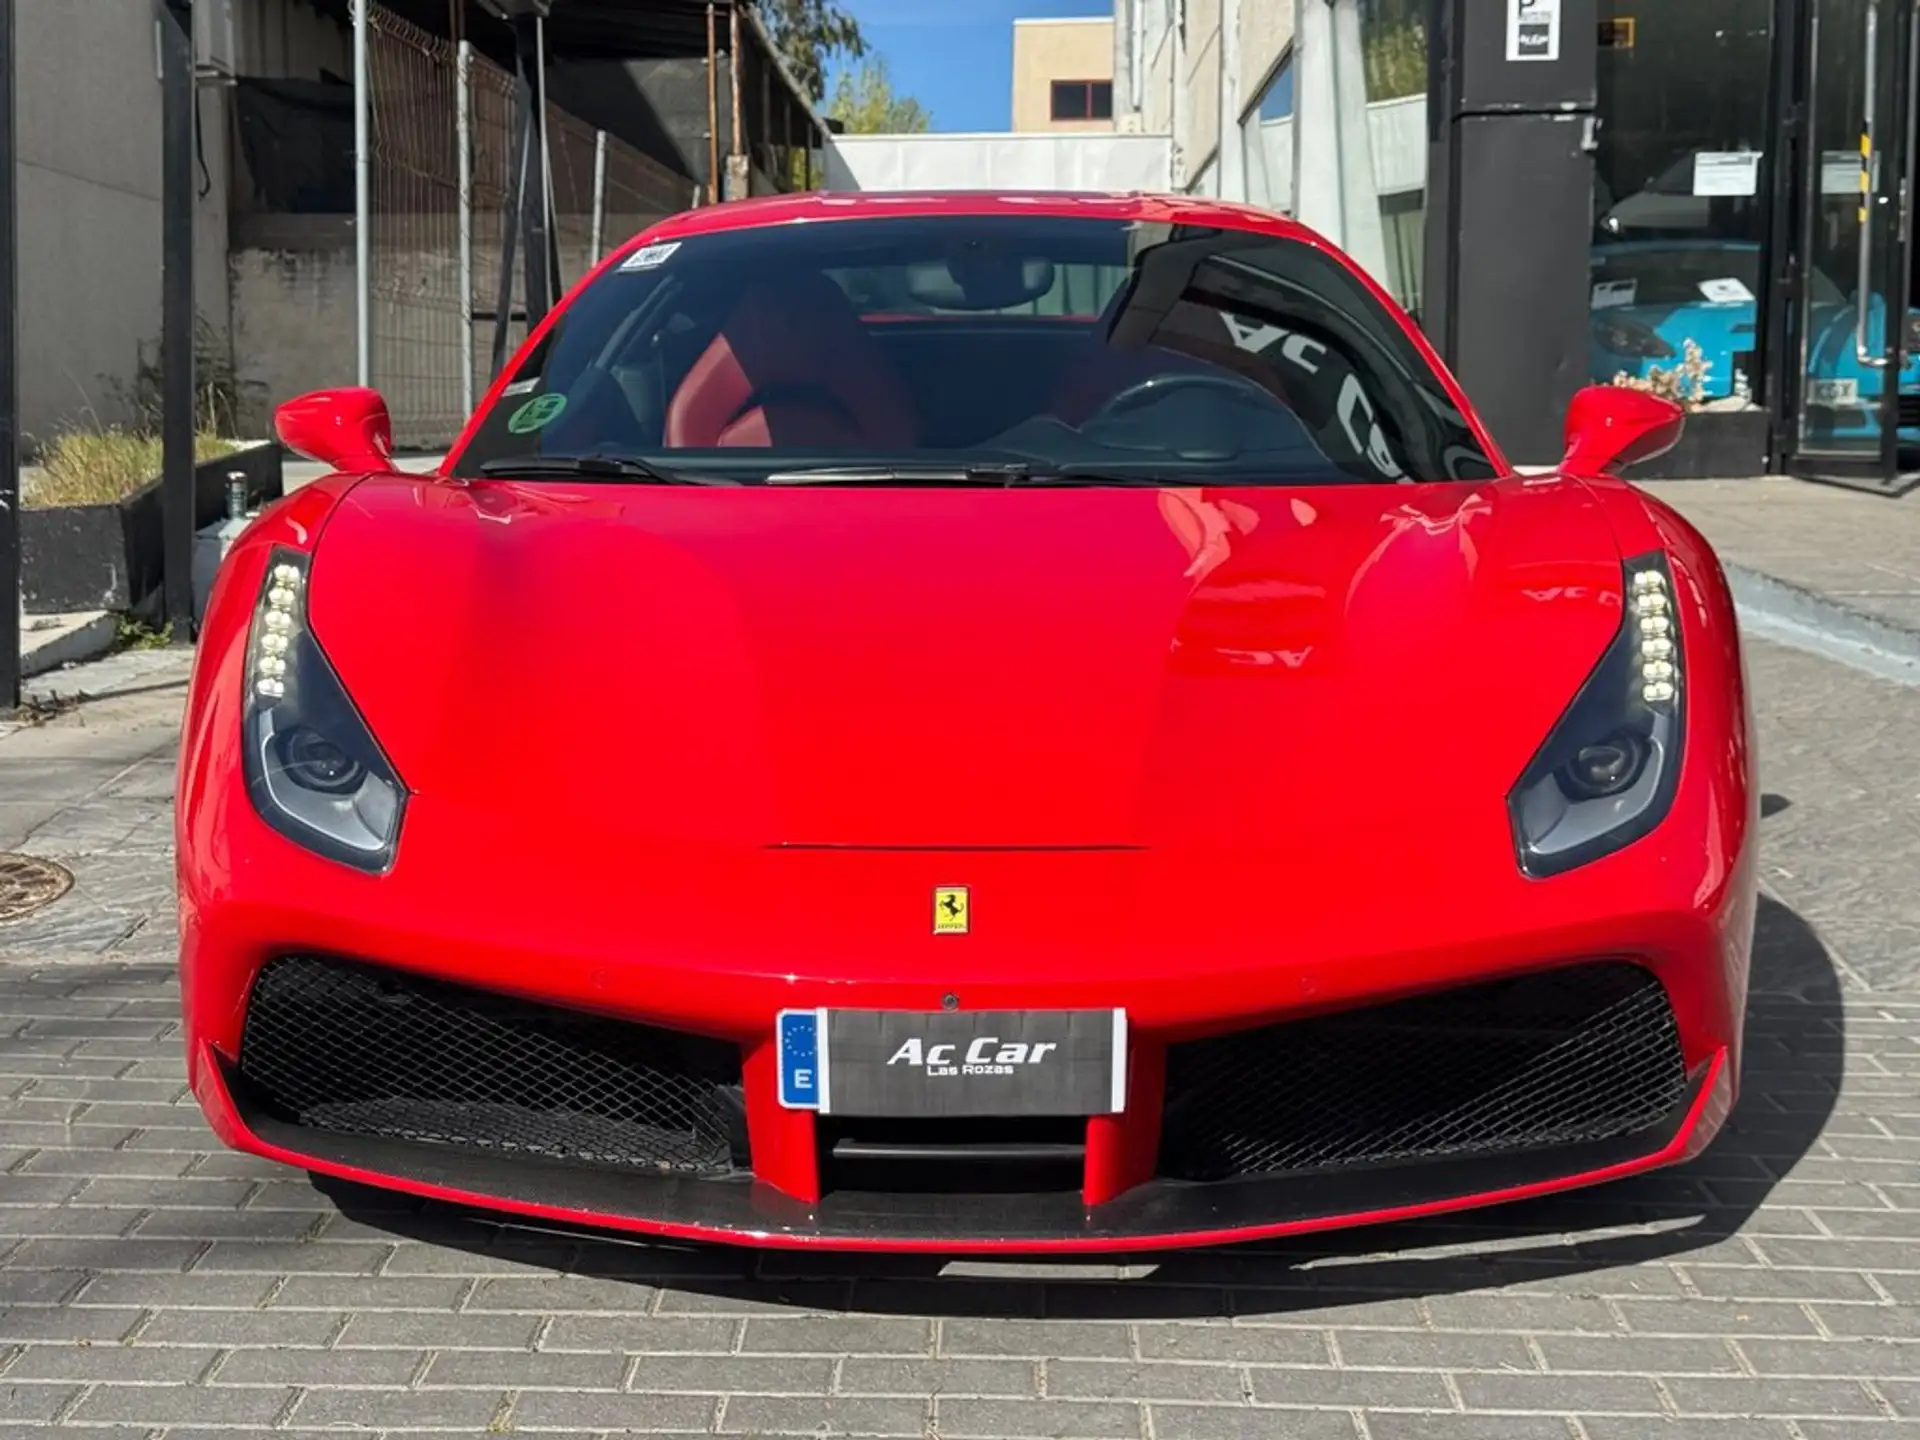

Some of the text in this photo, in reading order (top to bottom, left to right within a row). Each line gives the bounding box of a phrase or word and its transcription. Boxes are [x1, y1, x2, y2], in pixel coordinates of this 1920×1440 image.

[886, 1037, 1057, 1065] Ac Car
[793, 1069, 813, 1089] E
[926, 1064, 1014, 1076] Las Rozas
